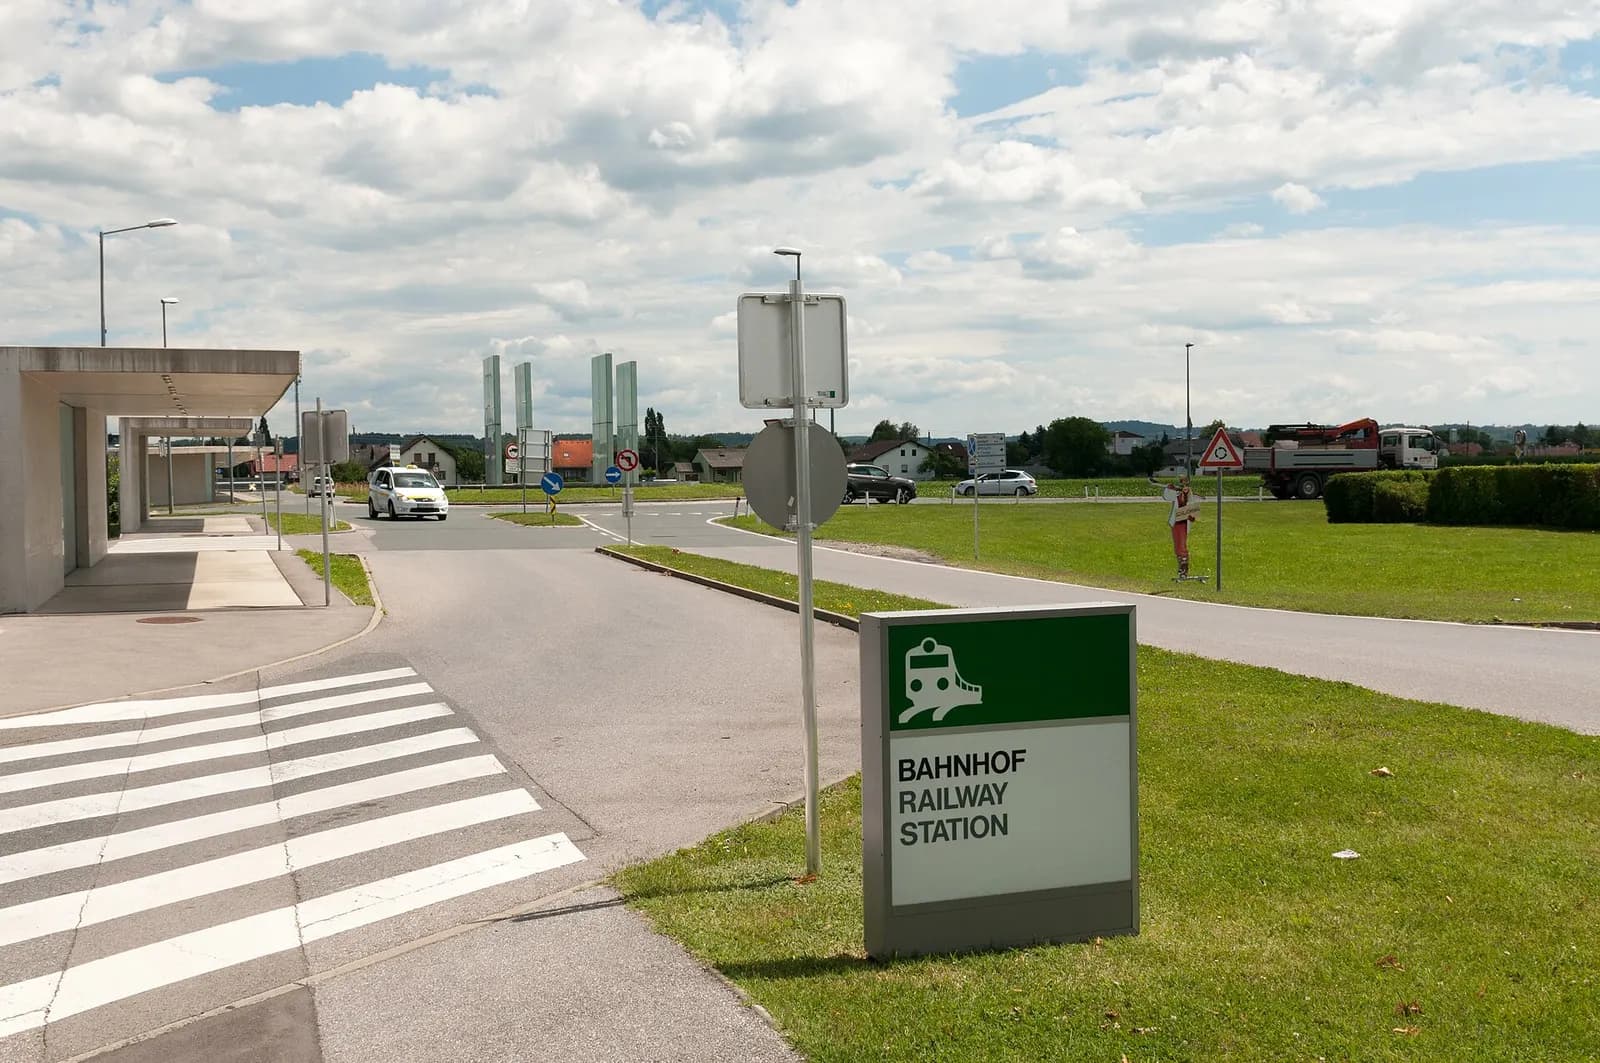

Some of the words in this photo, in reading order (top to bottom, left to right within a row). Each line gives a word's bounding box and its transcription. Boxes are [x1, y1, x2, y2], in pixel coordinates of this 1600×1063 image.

[898, 749, 1027, 782] BAHNHOF
[899, 782, 1009, 814] RAILWAY
[900, 814, 1009, 846] STATION
